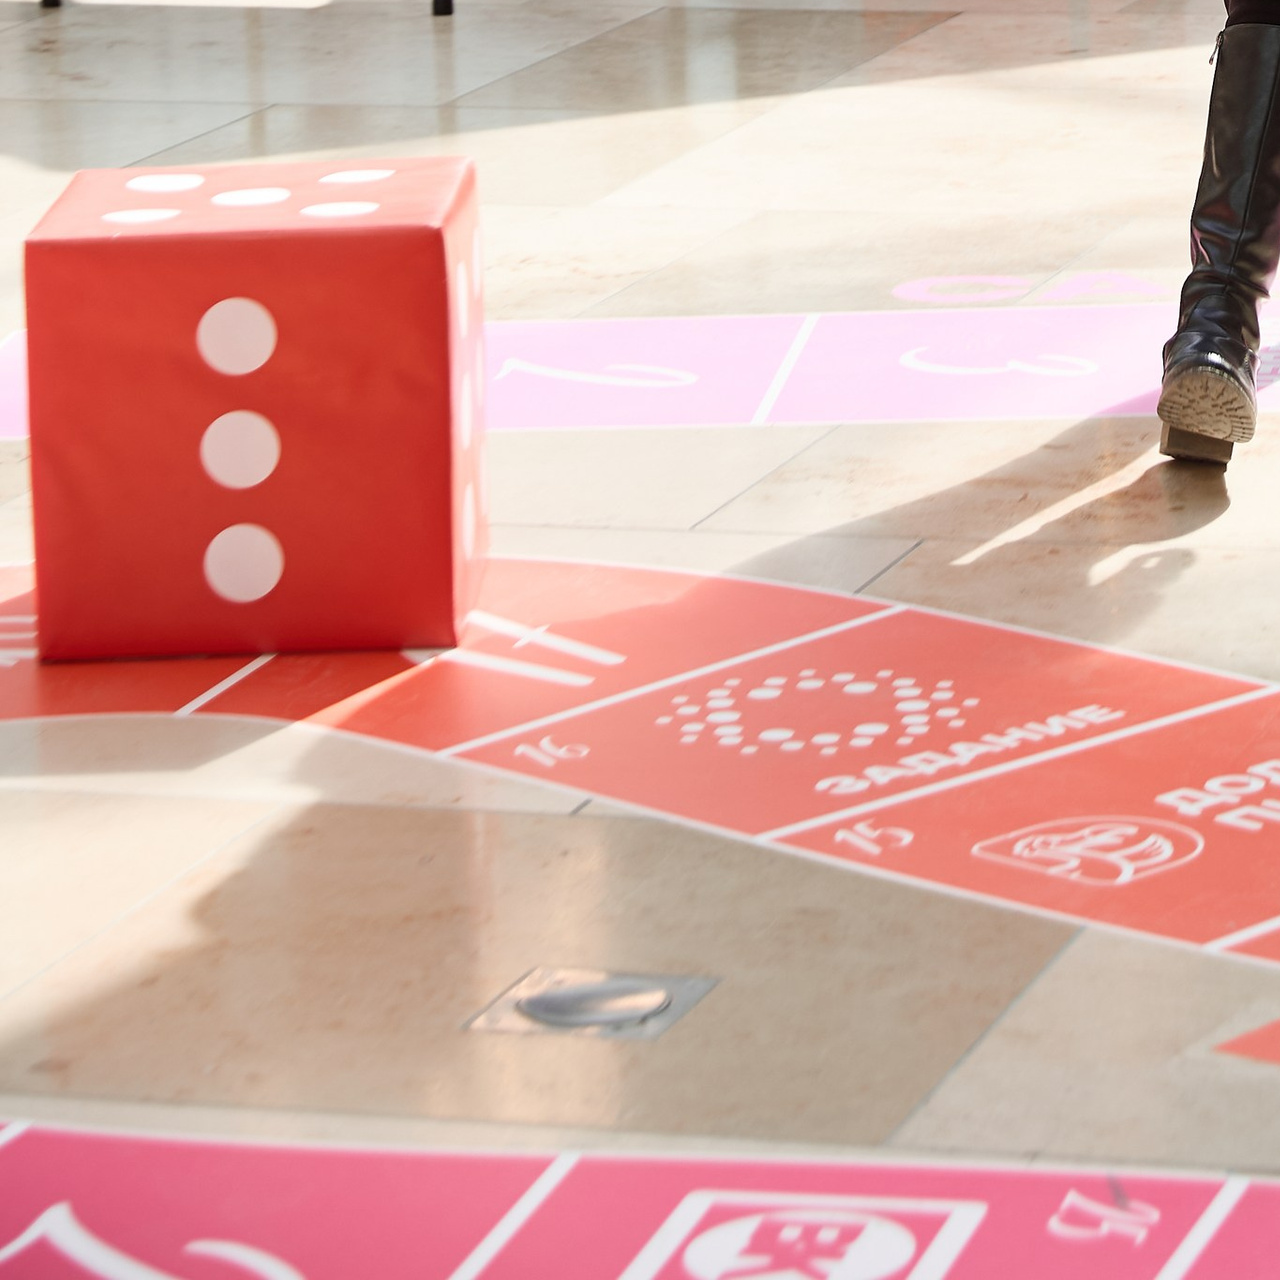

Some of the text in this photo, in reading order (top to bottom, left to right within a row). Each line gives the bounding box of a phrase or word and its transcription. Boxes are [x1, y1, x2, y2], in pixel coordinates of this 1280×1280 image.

[512, 733, 592, 769] 16
[813, 702, 1128, 797] ЗАДАНИЕ
[833, 818, 915, 858] 15
